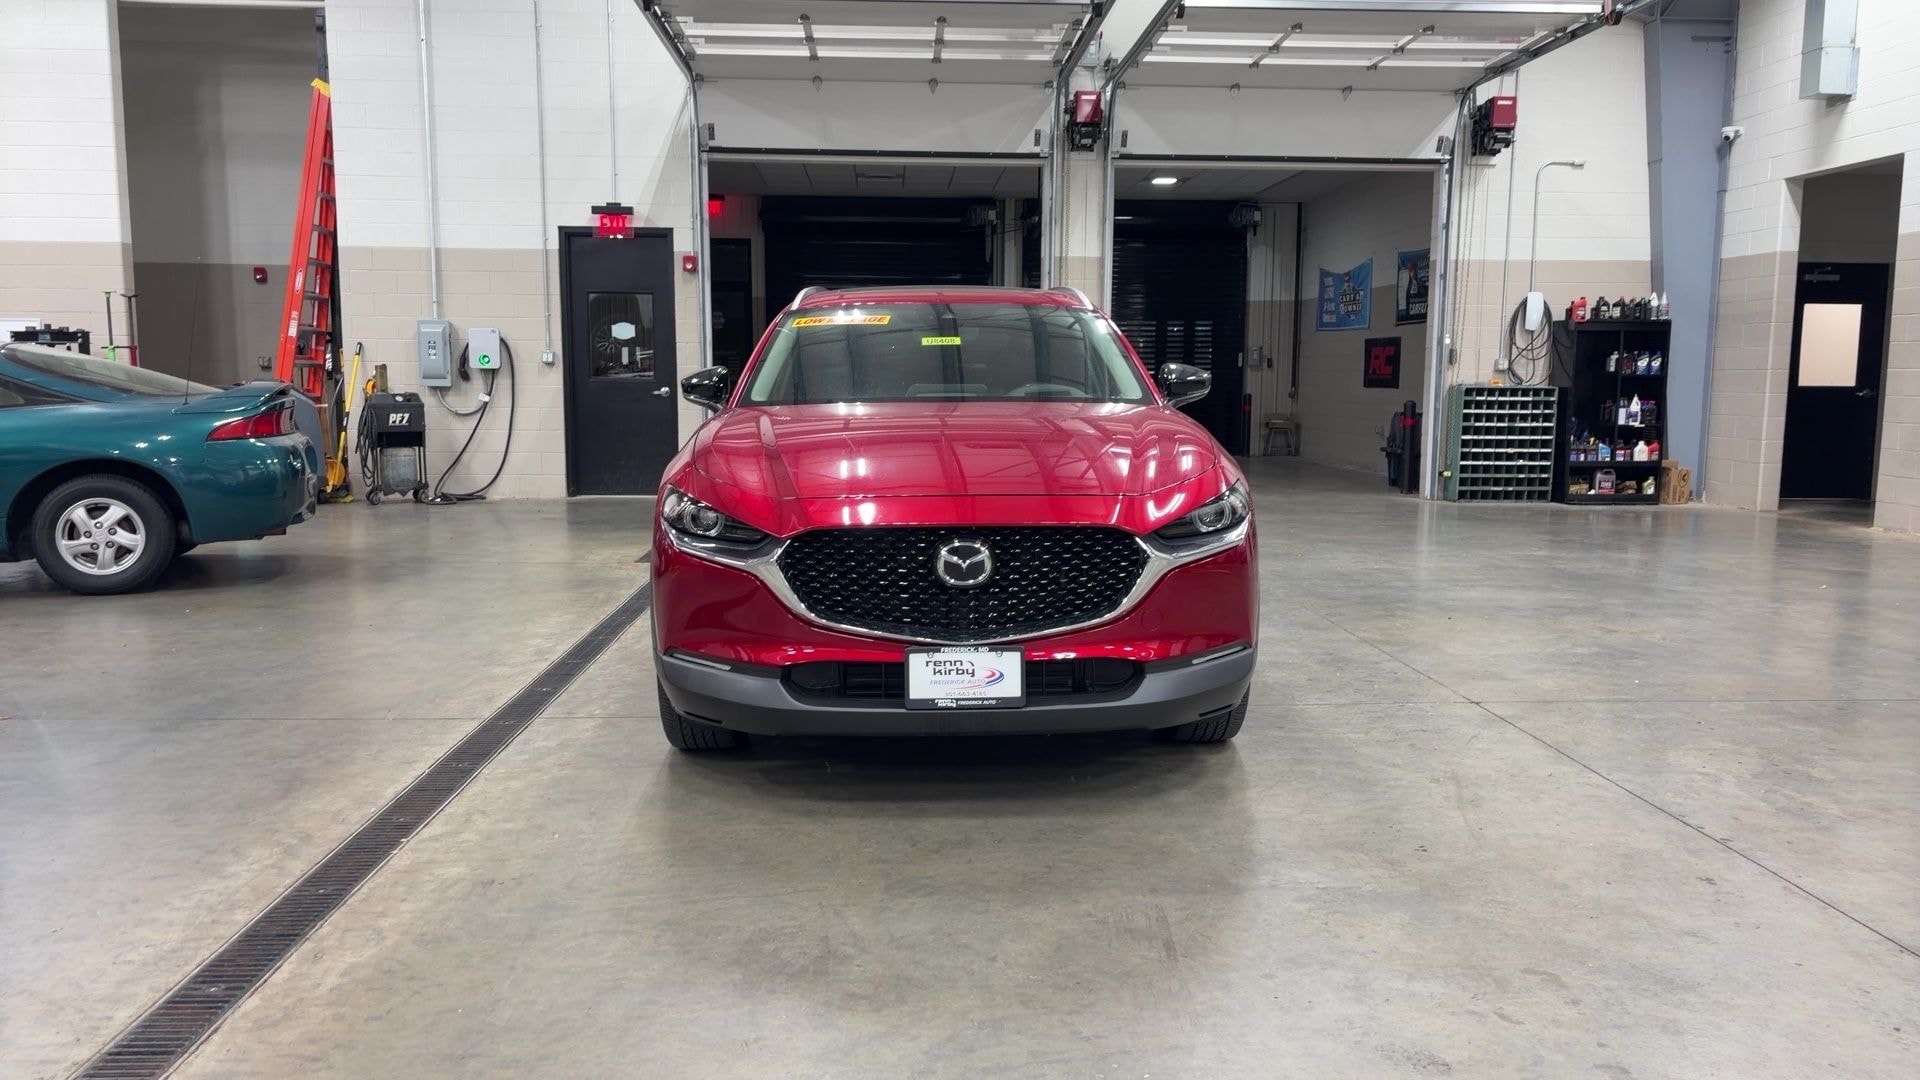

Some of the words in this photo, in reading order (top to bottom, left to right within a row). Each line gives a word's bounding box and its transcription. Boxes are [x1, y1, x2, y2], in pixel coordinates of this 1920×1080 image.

[600, 215, 628, 233] EXIT
[796, 317, 825, 325] LOW
[925, 659, 963, 667] renn
[932, 667, 975, 678] kirby
